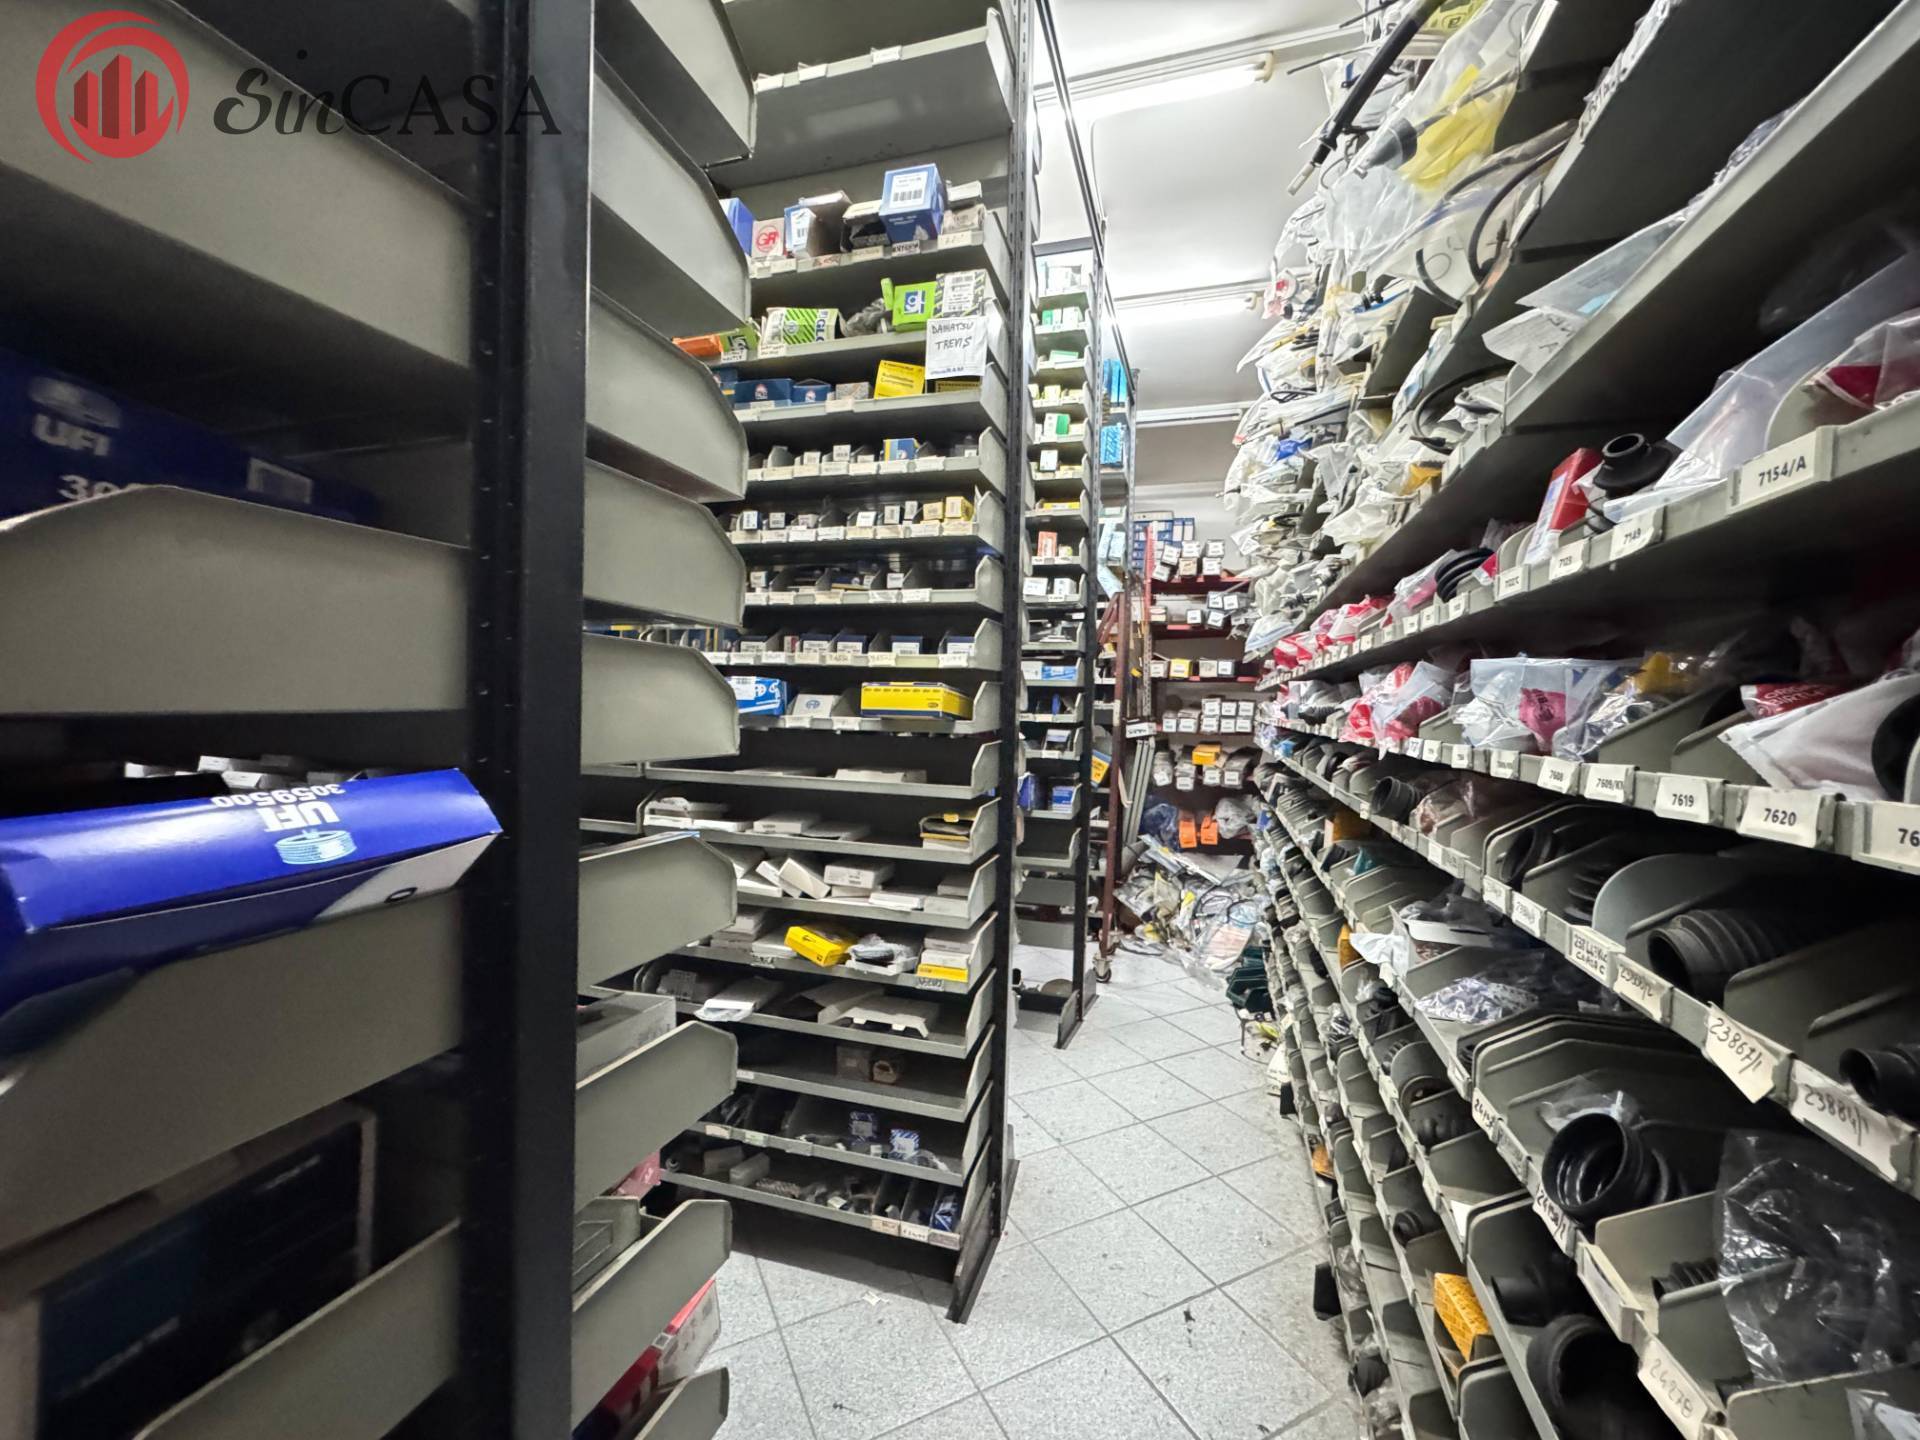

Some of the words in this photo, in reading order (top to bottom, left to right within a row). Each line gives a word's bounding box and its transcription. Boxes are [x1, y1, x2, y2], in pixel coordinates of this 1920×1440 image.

[32, 413, 109, 456] UFI
[1757, 454, 1807, 487] 7154/A
[211, 783, 346, 808] 3059500
[1671, 793, 1695, 808] 7619
[256, 800, 340, 832] UFI
[1763, 808, 1797, 827] 7620
